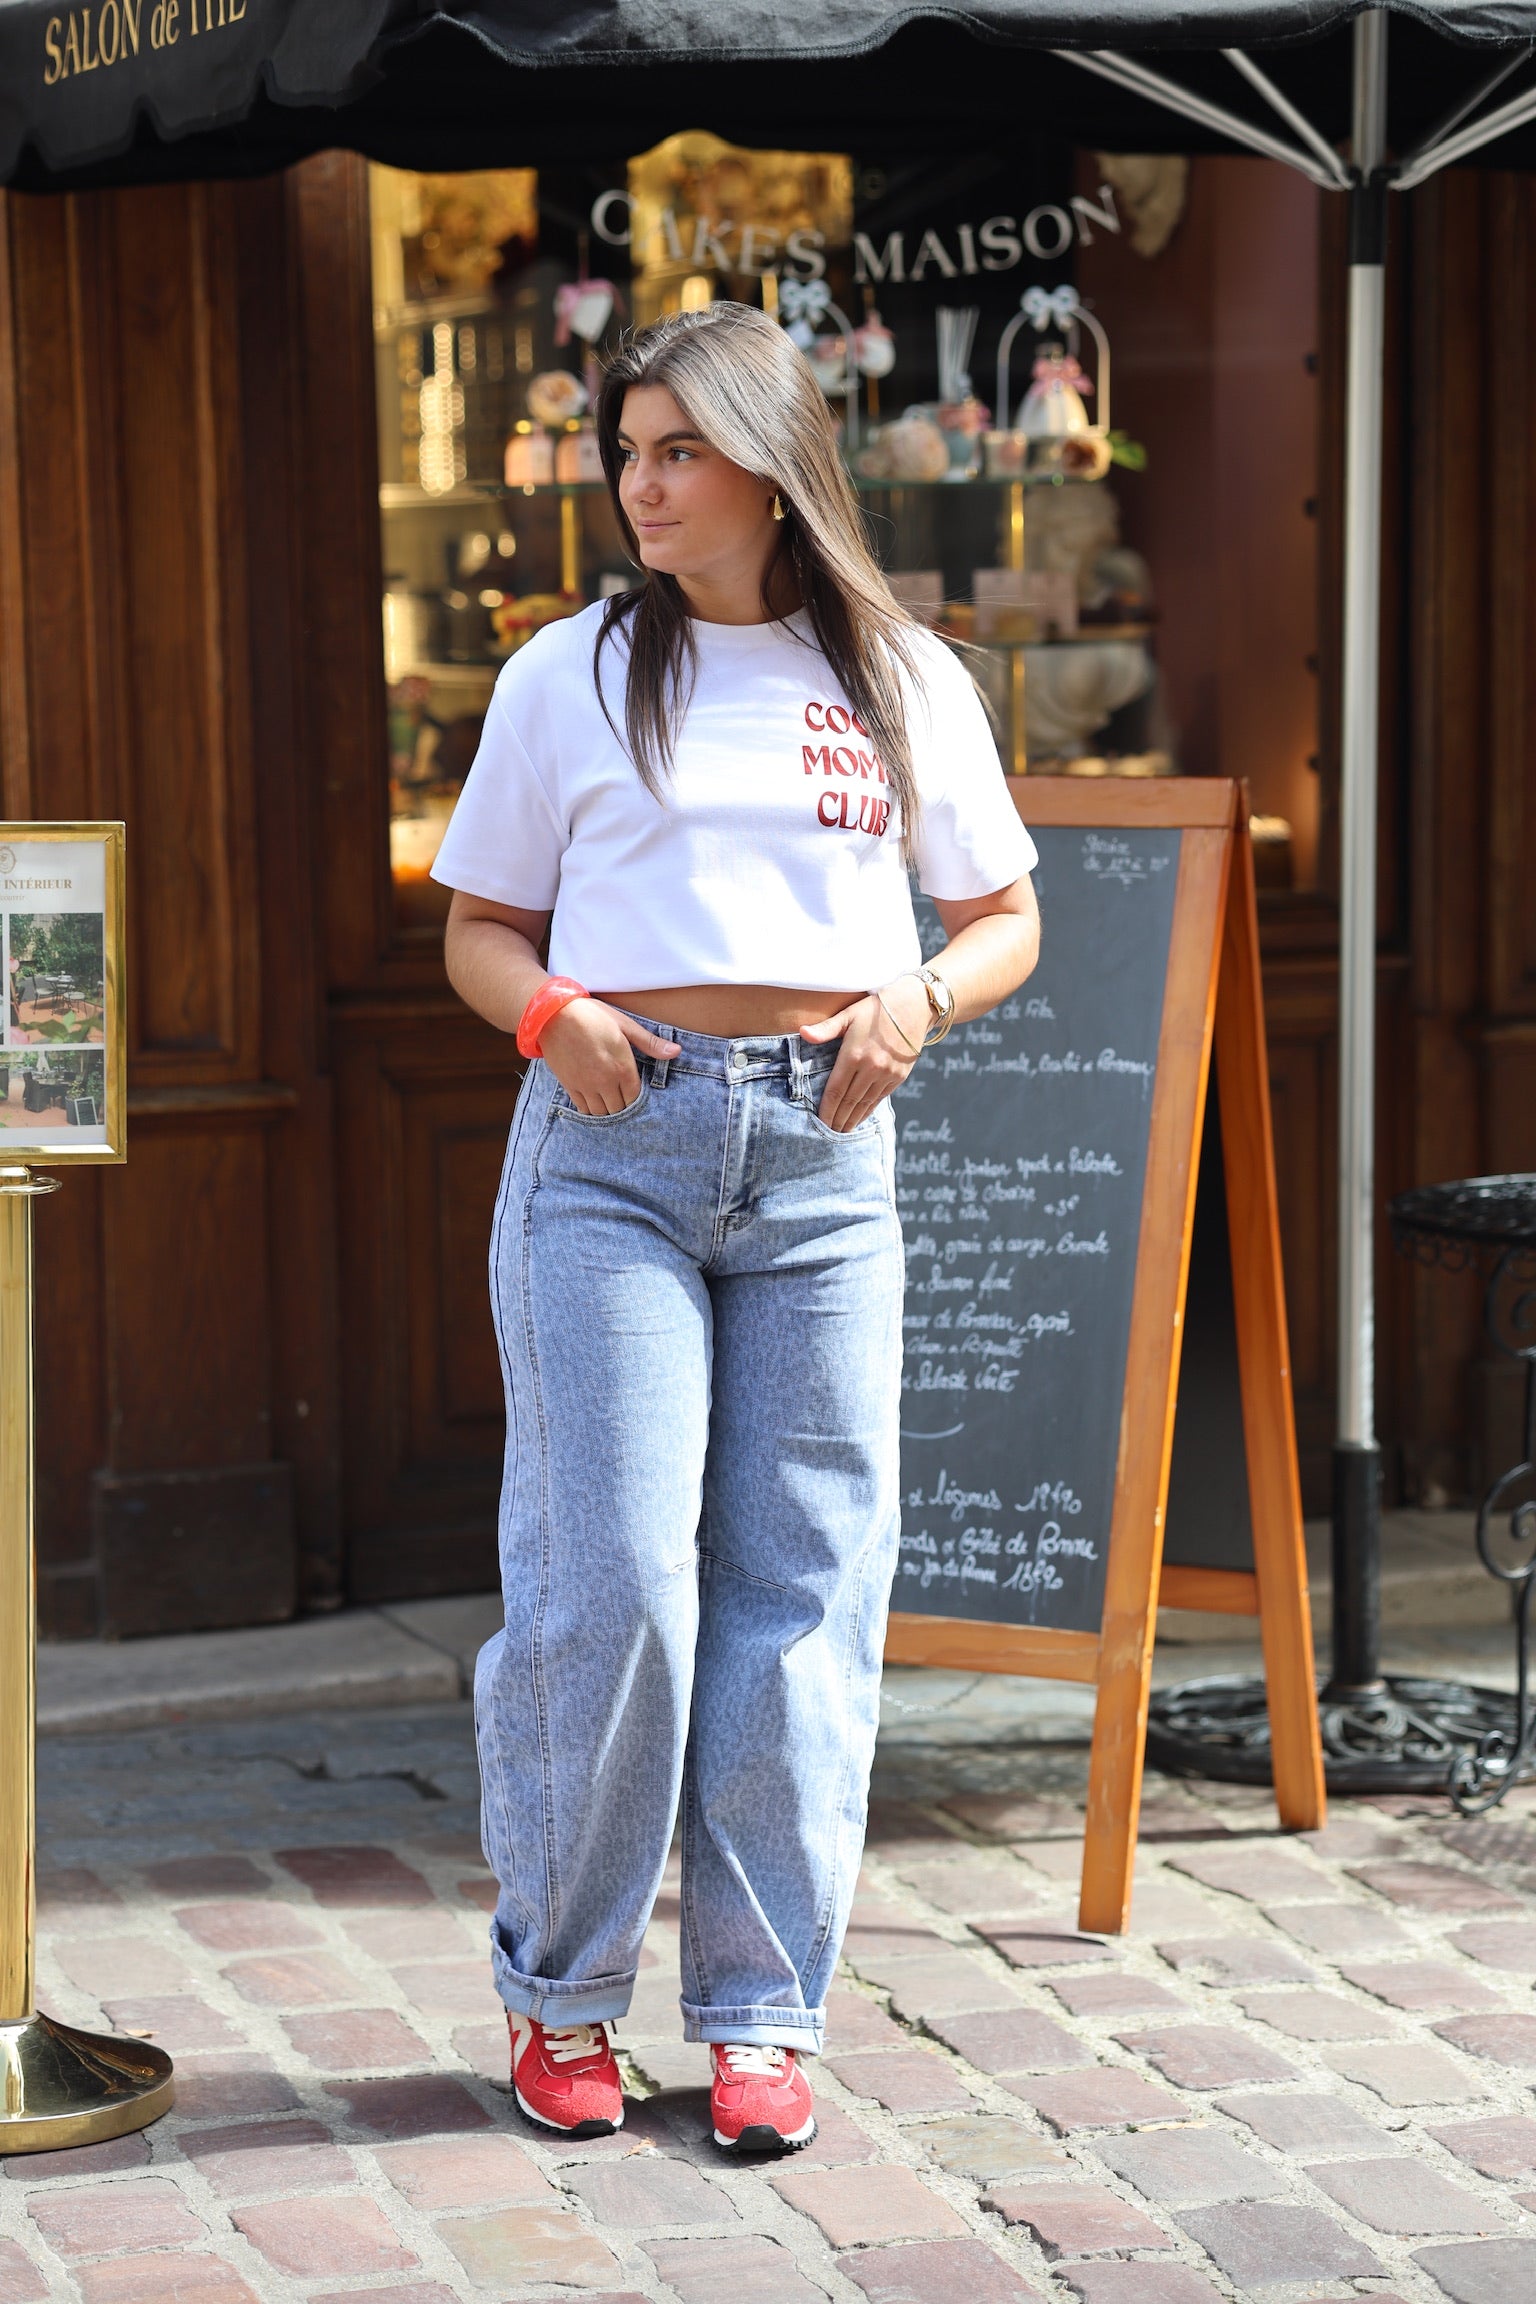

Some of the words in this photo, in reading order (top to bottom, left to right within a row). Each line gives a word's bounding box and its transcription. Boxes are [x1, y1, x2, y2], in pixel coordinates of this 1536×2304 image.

[44, 0, 142, 85] SALON
[150, 0, 181, 50] de
[591, 189, 827, 280] CAKES
[853, 185, 1121, 284] MAISON
[817, 791, 891, 837] CLUB
[4, 877, 73, 889] INTÉRIEUR
